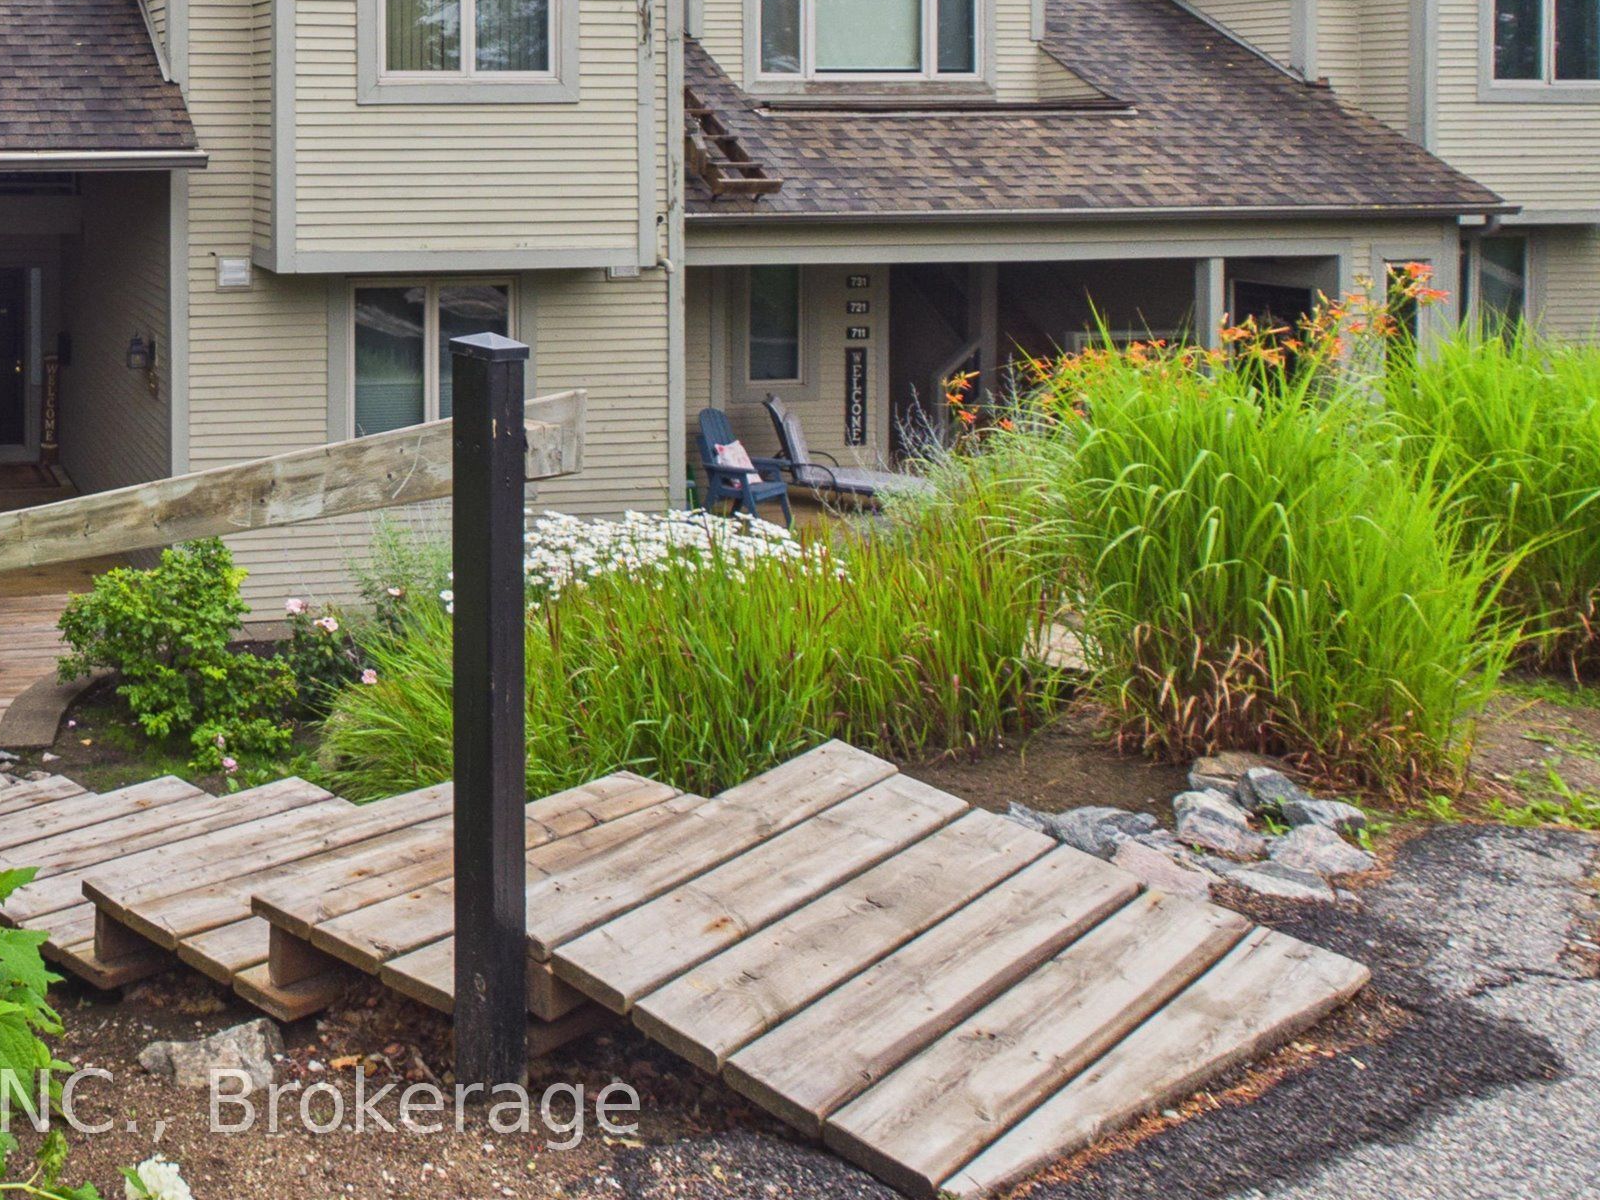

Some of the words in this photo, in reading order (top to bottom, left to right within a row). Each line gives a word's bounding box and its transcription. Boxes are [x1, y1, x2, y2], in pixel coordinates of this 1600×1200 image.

[850, 275, 867, 288] 731
[850, 301, 867, 313] 721
[851, 327, 867, 338] 711
[45, 363, 58, 441] WELCOME
[851, 351, 863, 441] WELCOME
